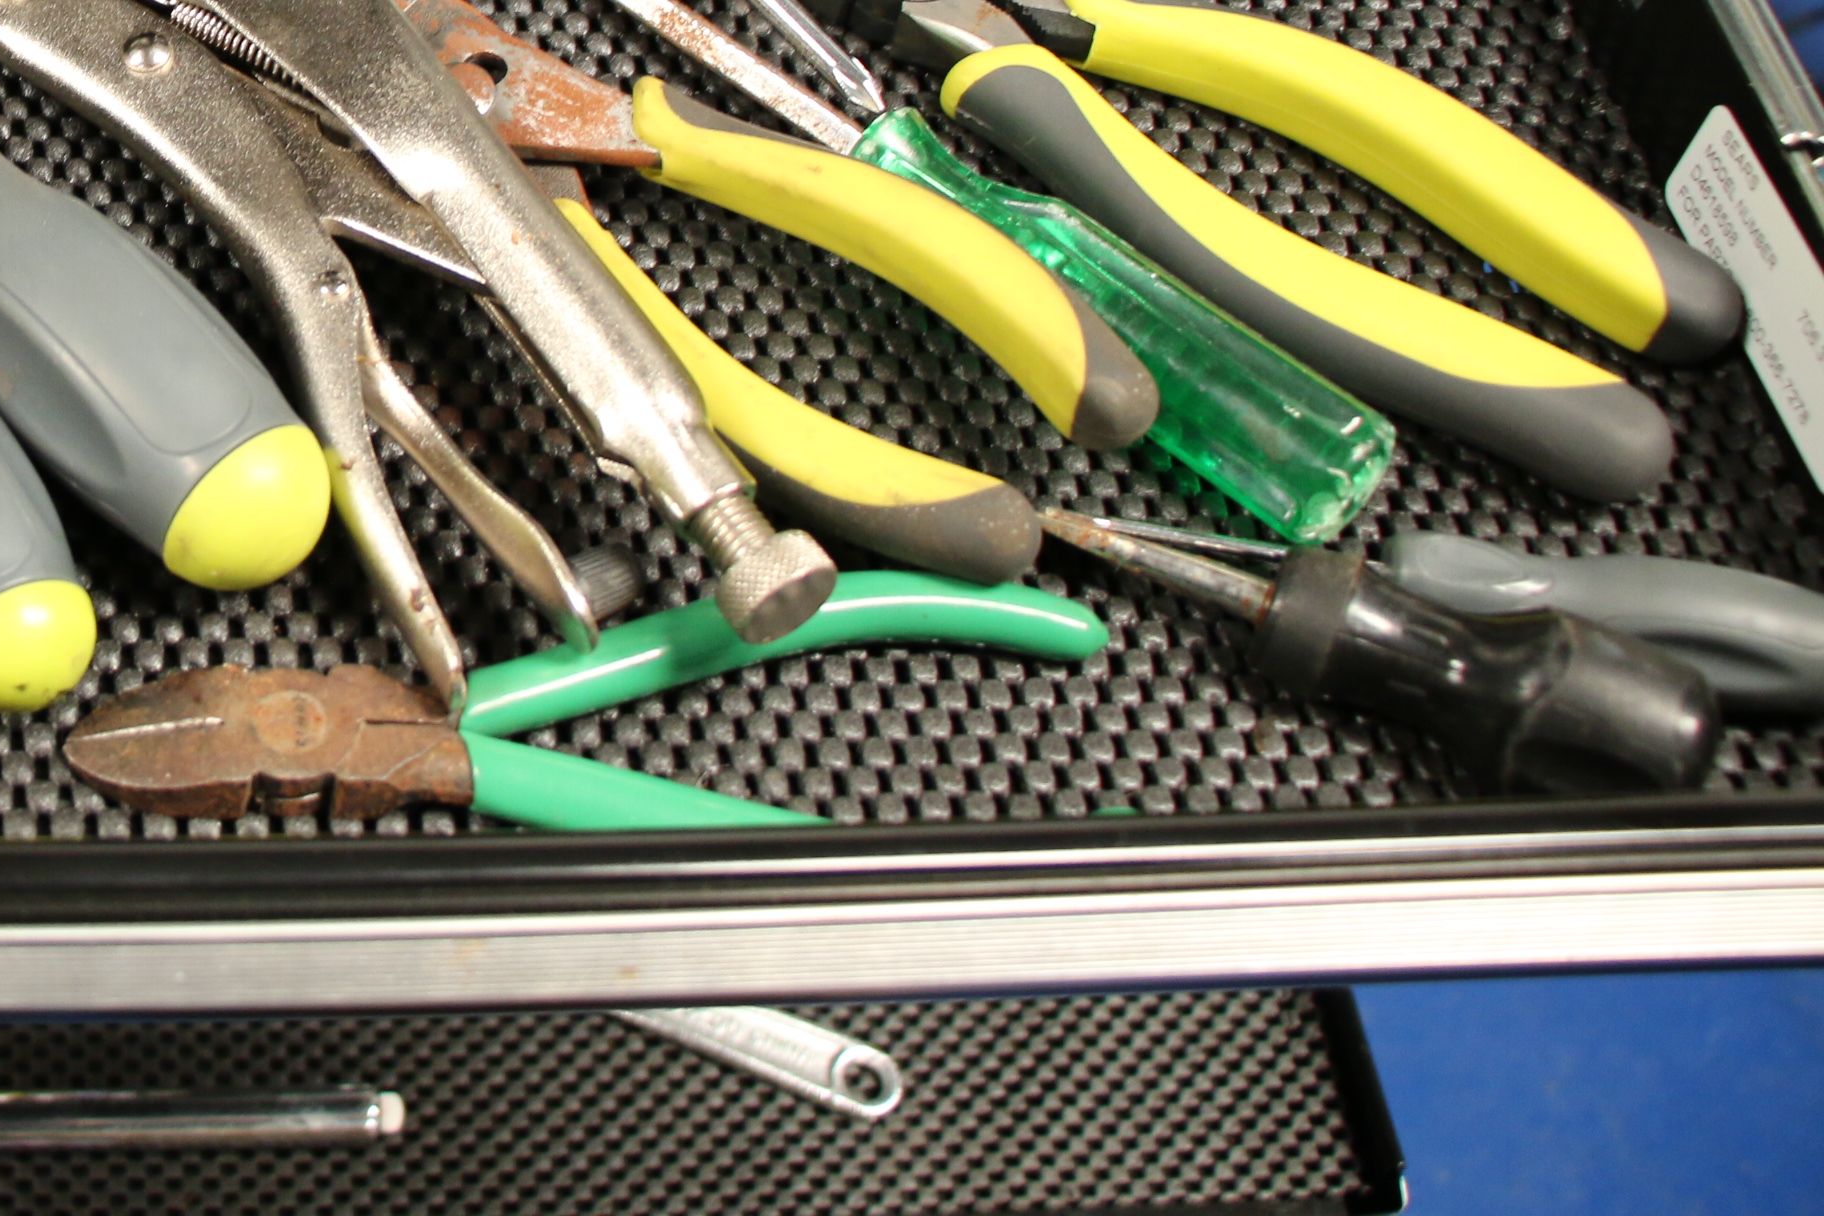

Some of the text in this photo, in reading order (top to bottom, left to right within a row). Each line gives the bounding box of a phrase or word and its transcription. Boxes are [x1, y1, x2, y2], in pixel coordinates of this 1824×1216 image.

[1721, 129, 1760, 191] SEARS
[1677, 184, 1702, 225] FOR
[1704, 143, 1736, 202] MODEL
[1736, 198, 1779, 271] NUMBER
